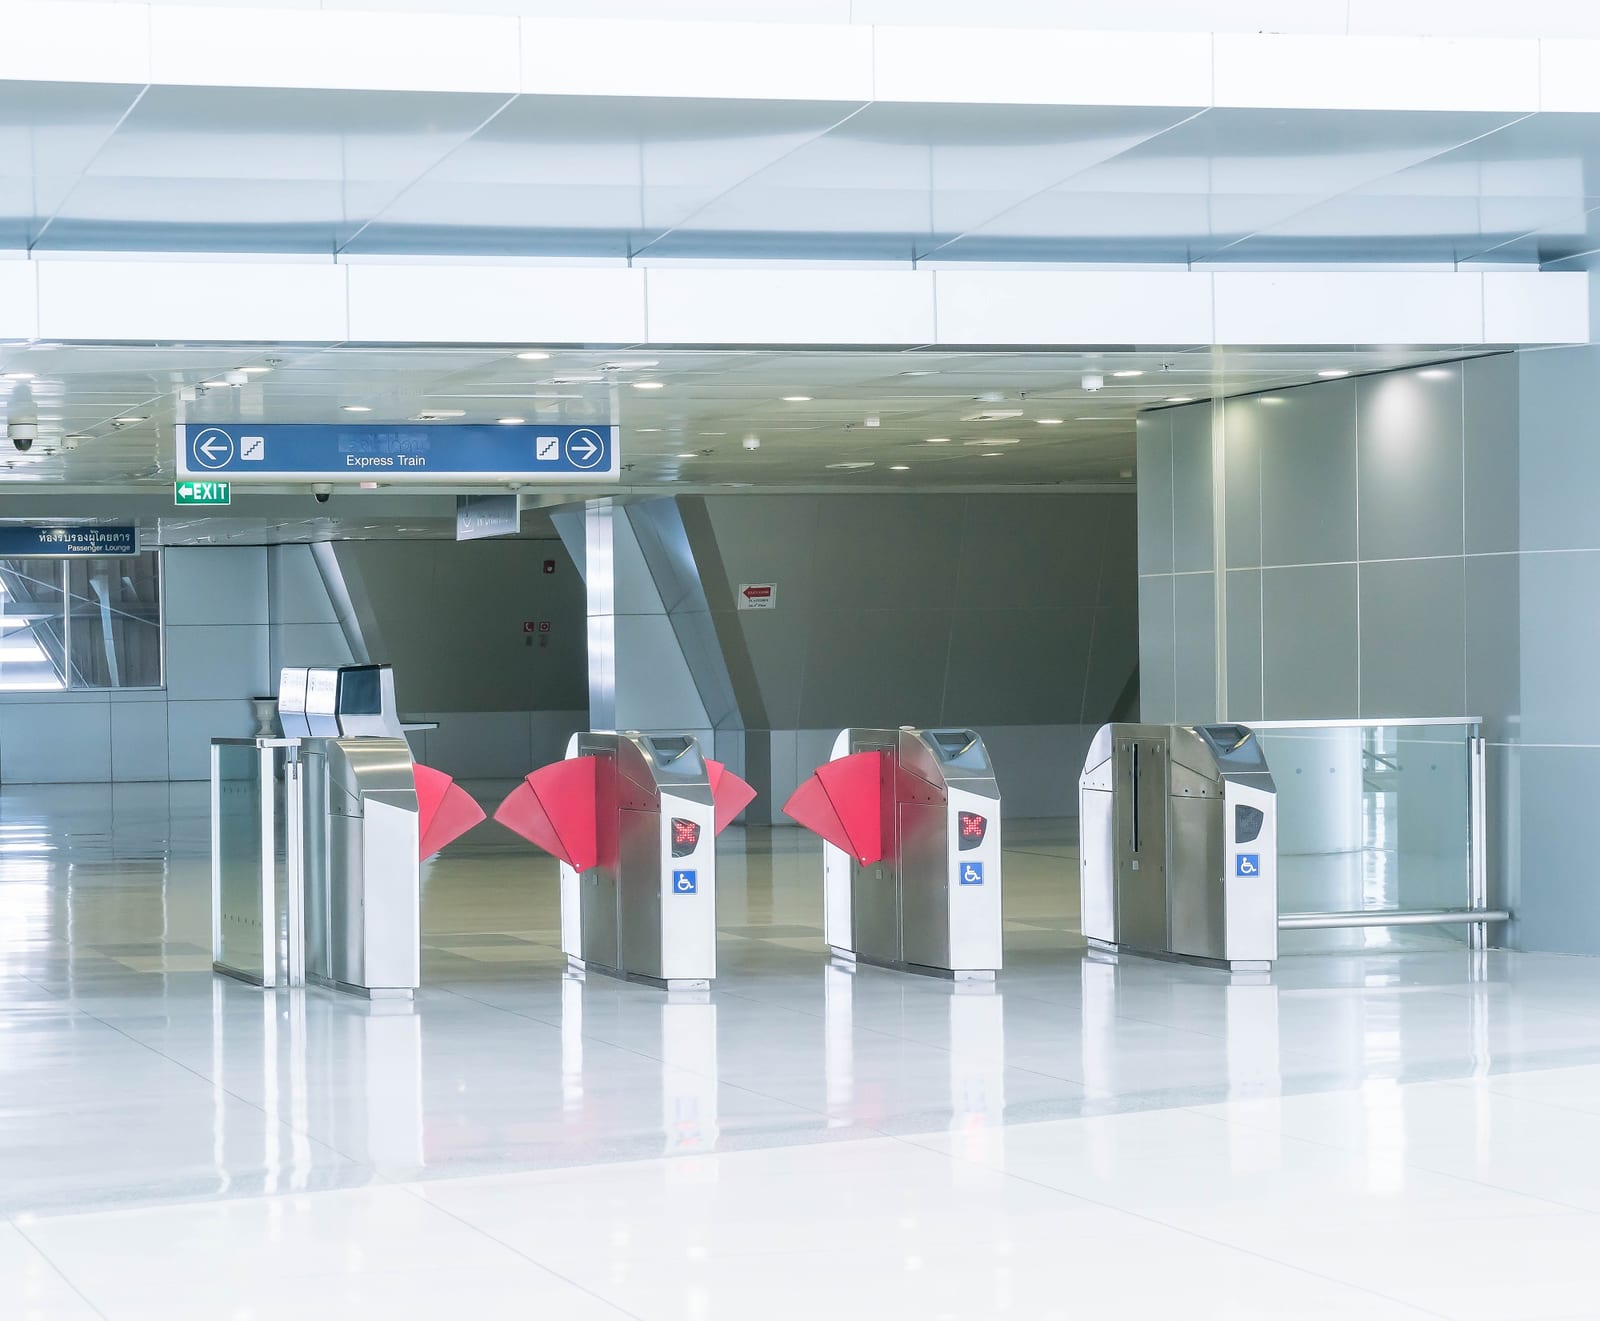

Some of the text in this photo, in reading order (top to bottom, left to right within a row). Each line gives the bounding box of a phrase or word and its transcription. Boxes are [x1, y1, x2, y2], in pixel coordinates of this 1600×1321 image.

[346, 454, 426, 468] Express Train
[193, 483, 228, 500] EXIT
[67, 544, 131, 553] Passenger Lounge
